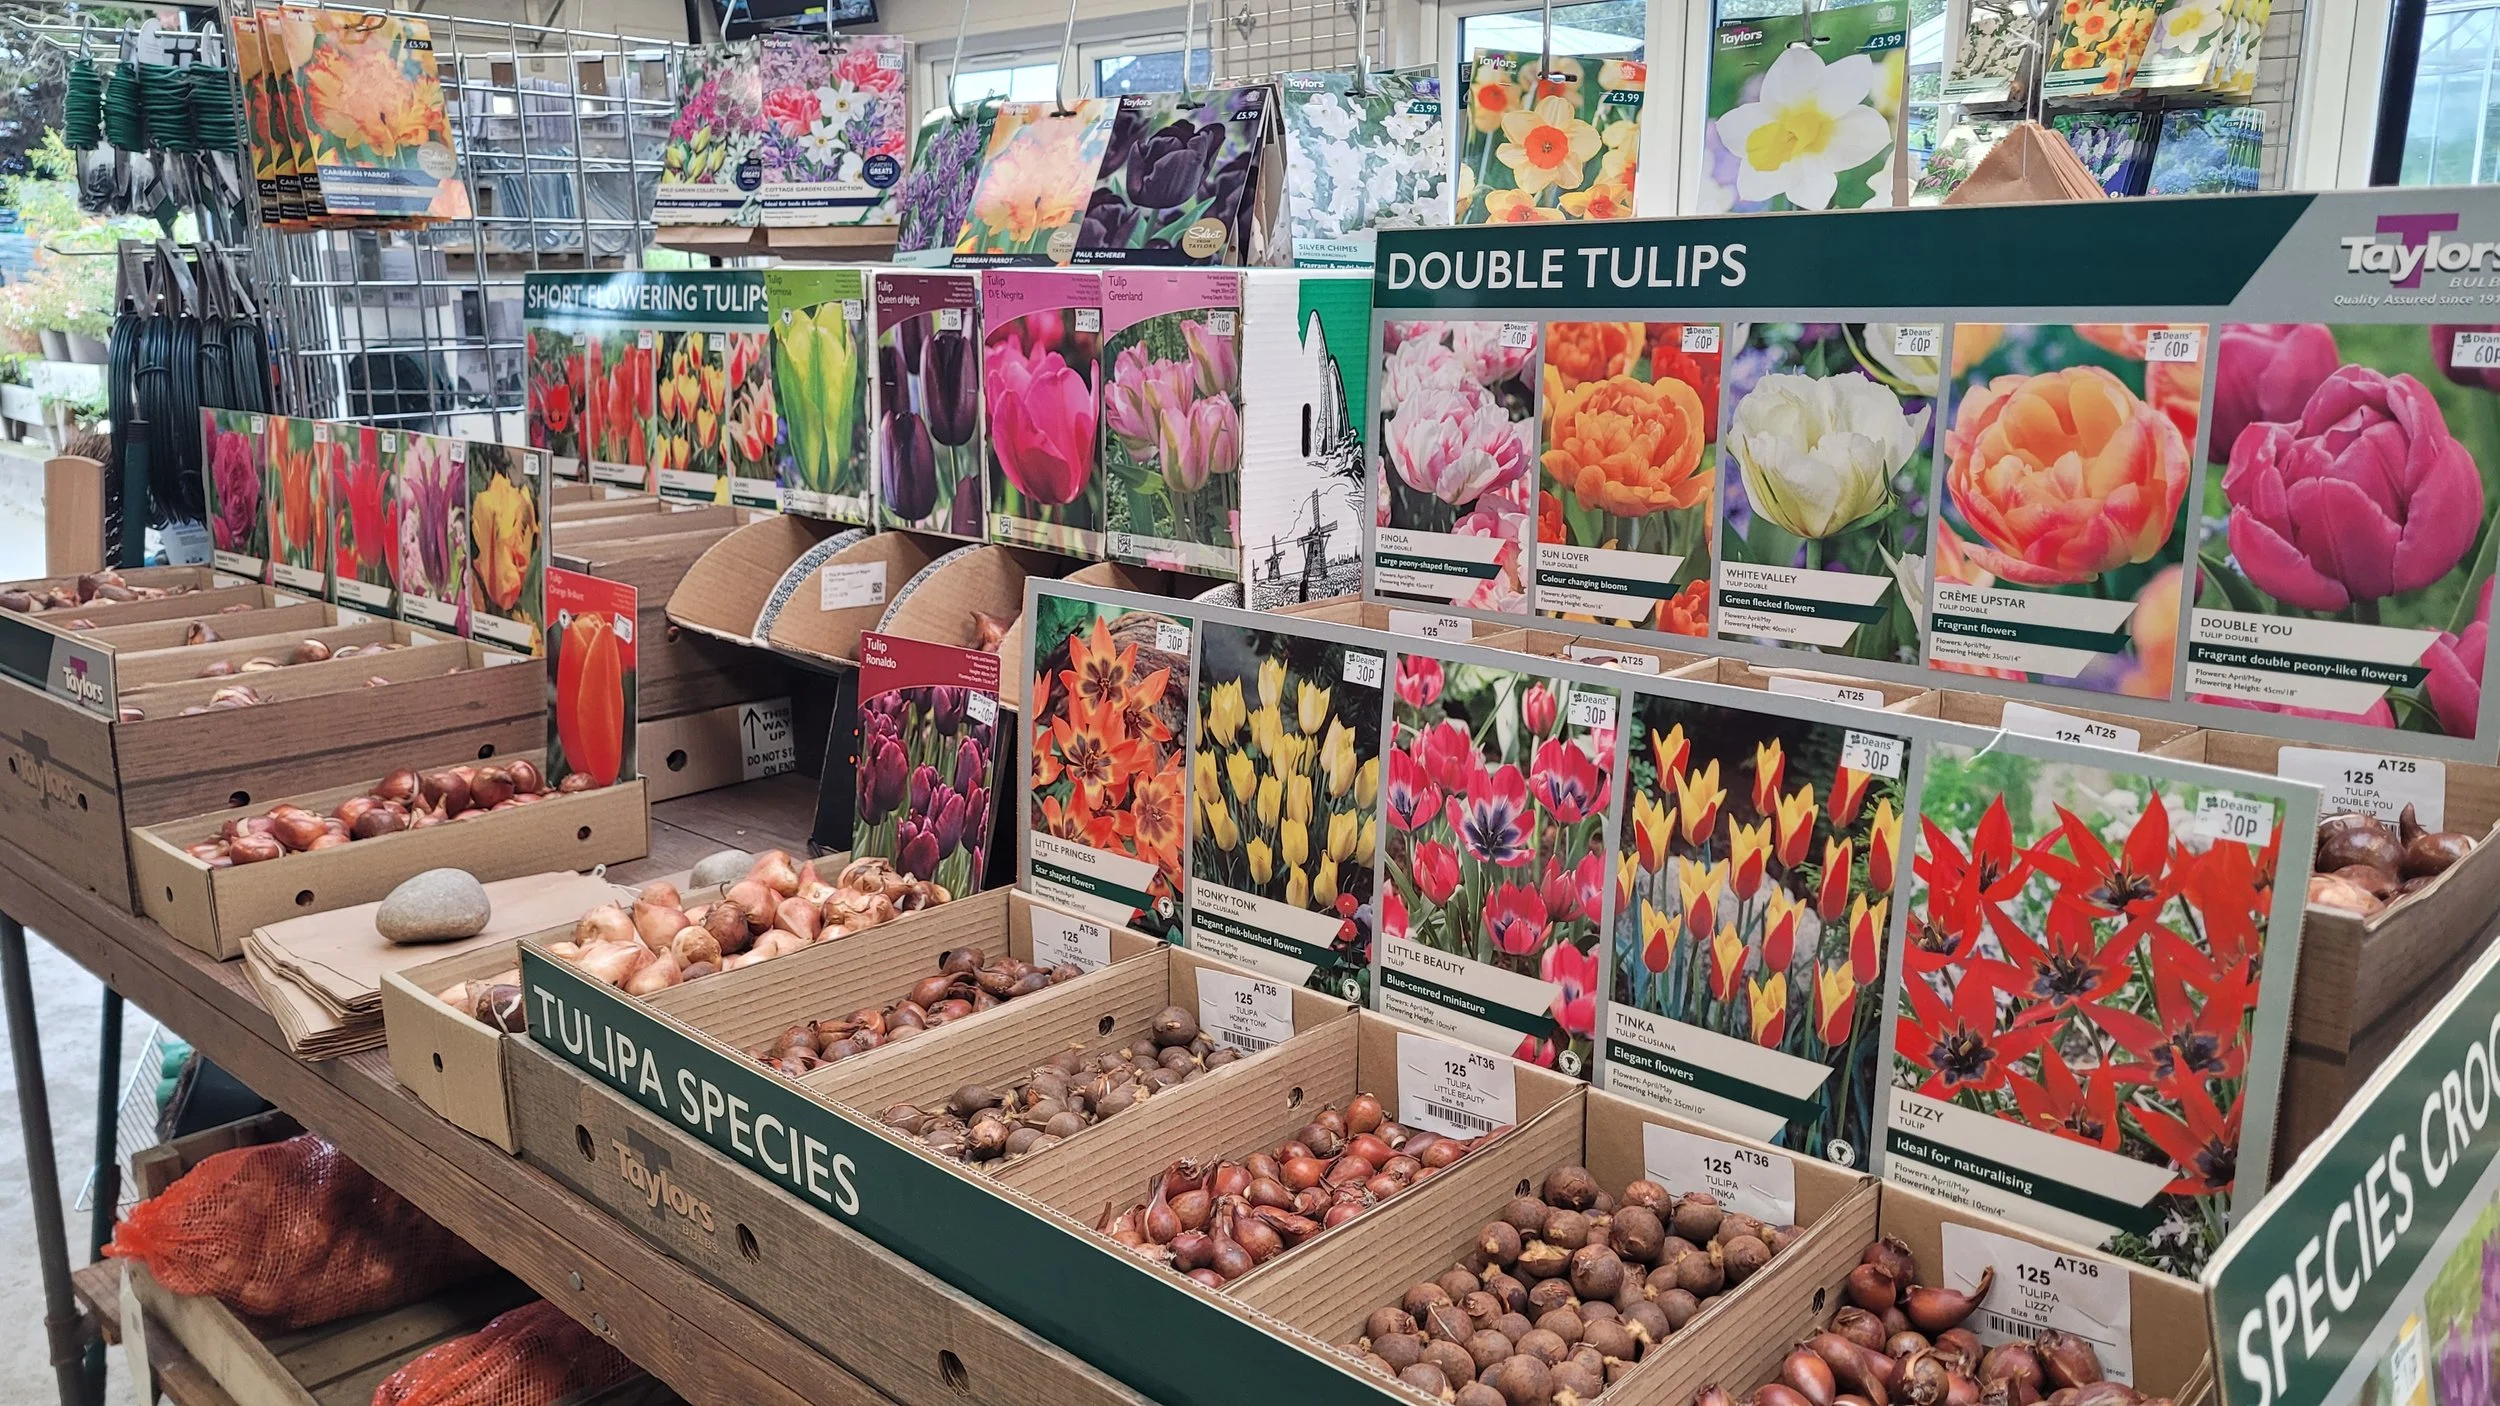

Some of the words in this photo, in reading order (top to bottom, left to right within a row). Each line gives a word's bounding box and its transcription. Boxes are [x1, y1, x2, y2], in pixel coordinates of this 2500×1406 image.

[762, 38, 792, 48] Taylors
[1720, 30, 1762, 45] Taylors
[1870, 34, 1901, 48] £3.99
[1478, 56, 1517, 70] Taylors
[1288, 78, 1324, 90] Taylors
[1122, 98, 1152, 108] Taylors
[1612, 92, 1640, 103] £3.99
[1236, 110, 1258, 120] £5.99
[1414, 104, 1438, 114] £3.99
[322, 168, 363, 178] CARIBBEAN
[364, 170, 390, 179] PARROT
[868, 168, 893, 176] GREATS
[1187, 226, 1222, 240] Select
[1388, 248, 1565, 290] DOUBLE
[1578, 244, 1747, 288] TULIPS
[877, 281, 893, 292] Tulip
[987, 276, 1006, 288] Tulip
[1108, 276, 1128, 288] Tulip
[528, 284, 583, 310] SHORT
[587, 285, 698, 311] FLOWERING
[701, 284, 769, 312] TULIPS
[878, 294, 896, 304] Queen
[898, 294, 904, 304] of
[904, 296, 920, 306] Night
[1001, 290, 1024, 300] Negrita
[1108, 290, 1143, 302] Greenland
[2334, 294, 2380, 307] Quality
[2384, 292, 2438, 306] Assured
[2440, 294, 2474, 305] since
[1218, 320, 1230, 332] 40P
[1512, 331, 1526, 344] 60P
[1694, 335, 1712, 349] 60P
[1910, 337, 1930, 352] 60P
[2164, 341, 2188, 357] 60P
[1380, 534, 1408, 544] FINOLA
[1542, 550, 1560, 559] SUN
[1562, 552, 1590, 562] LOVER
[1380, 556, 1398, 566] Large
[1398, 560, 1442, 571] peony-shaped
[1444, 563, 1468, 574] flowers
[548, 571, 563, 584] Tulip
[1542, 574, 1566, 582] Colour
[1568, 577, 1600, 590] changing
[1600, 582, 1628, 591] blooms
[1726, 568, 1760, 580] WHITE
[1760, 572, 1798, 584] VALLEY
[1725, 594, 1750, 606] Green
[1752, 598, 1782, 608] flecked
[1784, 602, 1816, 612] flowers
[1940, 590, 1978, 603] CRÈME
[1980, 595, 2026, 609] UPSTAR
[1960, 606, 1988, 614] DOUBLE
[1438, 618, 1458, 628] AT25
[1938, 618, 1978, 632] Fragrant
[1980, 624, 2017, 636] flowers
[2200, 617, 2258, 633] DOUBLE
[2262, 624, 2293, 636] YOU
[1422, 626, 1438, 636] 125
[2199, 631, 2223, 640] TULIP
[2224, 634, 2260, 644] DOUBLE
[866, 637, 887, 654] Tulip
[1167, 635, 1182, 652] 30P
[866, 653, 897, 669] Ronaldo
[1620, 656, 1644, 666] AT25
[2197, 648, 2247, 664] Fragrant
[2250, 652, 2290, 668] double
[2294, 656, 2358, 679] peony-like
[2360, 666, 2408, 682] flowers
[1356, 665, 1375, 683] 30P
[62, 666, 104, 703] Taylors
[1838, 690, 1865, 702] AT25
[762, 708, 789, 720] THIS
[1584, 706, 1606, 725] 30P
[763, 720, 790, 731] WAY
[2084, 724, 2117, 740] AT25
[770, 731, 786, 741] UP
[2056, 730, 2081, 743] 125
[748, 755, 760, 766] DO
[762, 750, 780, 762] NOT
[782, 748, 796, 759] ST
[1862, 749, 1890, 770] 30P
[764, 765, 777, 775] ON
[2378, 760, 2416, 774] AT25
[15, 752, 78, 810] Taylors
[2344, 770, 2374, 784] 125
[2344, 787, 2380, 798] TULIPA
[2332, 796, 2370, 808] DOUBLE
[2372, 800, 2394, 810] YOU
[2221, 813, 2257, 838] 30P
[1036, 838, 1059, 853] LITTLE
[1060, 846, 1096, 864] PRINCESS
[1035, 864, 1048, 874] Star
[1049, 870, 1071, 882] shaped
[1072, 876, 1095, 890] flowers
[1197, 886, 1229, 903] HONKY
[1230, 896, 1257, 912] TONK
[1062, 930, 1078, 943] 125
[1079, 924, 1098, 937] AT36
[1196, 914, 1224, 930] Elegant
[1225, 924, 1272, 945] pink-blushed
[1274, 938, 1302, 955] flowers
[1387, 956, 1405, 967] TULIP
[1388, 943, 1420, 962] LITTLE
[1423, 955, 1465, 975] BEAUTY
[1254, 983, 1277, 997] AT36
[1386, 973, 1441, 1000] Blue-centred
[1442, 991, 1486, 1014] miniature
[1234, 991, 1253, 1005] 125
[1236, 1006, 1258, 1017] TULIPA
[1229, 1014, 1249, 1024] HONKY
[1250, 1019, 1267, 1028] TONK
[1616, 1012, 1656, 1034] TINKA
[1616, 1027, 1636, 1039] TULIP
[1638, 1034, 1676, 1052] CLUSIANA
[1444, 1060, 1467, 1078] 125
[1468, 1054, 1495, 1070] AT36
[1614, 1046, 1652, 1066] Elegant
[1654, 1059, 1695, 1081] flowers
[1446, 1077, 1472, 1091] TULIPA
[533, 984, 668, 1109] TULIPA
[676, 1068, 860, 1217] SPECIES
[1434, 1084, 1457, 1096] LITTLE
[1458, 1091, 1485, 1105] BEAUTY
[1900, 1100, 1944, 1123] LIZZY
[1899, 1116, 1925, 1131] TULIP
[1703, 1156, 1732, 1175] 125
[1734, 1150, 1769, 1168] AT36
[1896, 1136, 1928, 1158] Ideal
[1930, 1148, 1950, 1164] for
[1954, 1156, 2034, 1196] naturalising
[612, 1138, 716, 1233] Taylors
[1705, 1175, 1739, 1190] TULIPA
[1894, 1162, 1930, 1181] Flowers:
[1932, 1174, 1970, 1195] April/May
[1710, 1186, 1736, 1201] TINKA
[1894, 1172, 1936, 1196] Flowering
[1937, 1186, 1969, 1206] Height:
[1972, 1197, 2006, 1217] 10cm/4"
[682, 1223, 718, 1255] BULBS
[2054, 1256, 2098, 1278] AT36
[2237, 1133, 2414, 1406] SPECIES
[2016, 1264, 2051, 1286] 125
[2018, 1285, 2060, 1302] TULIPA
[2025, 1299, 2055, 1314] LIZZY
